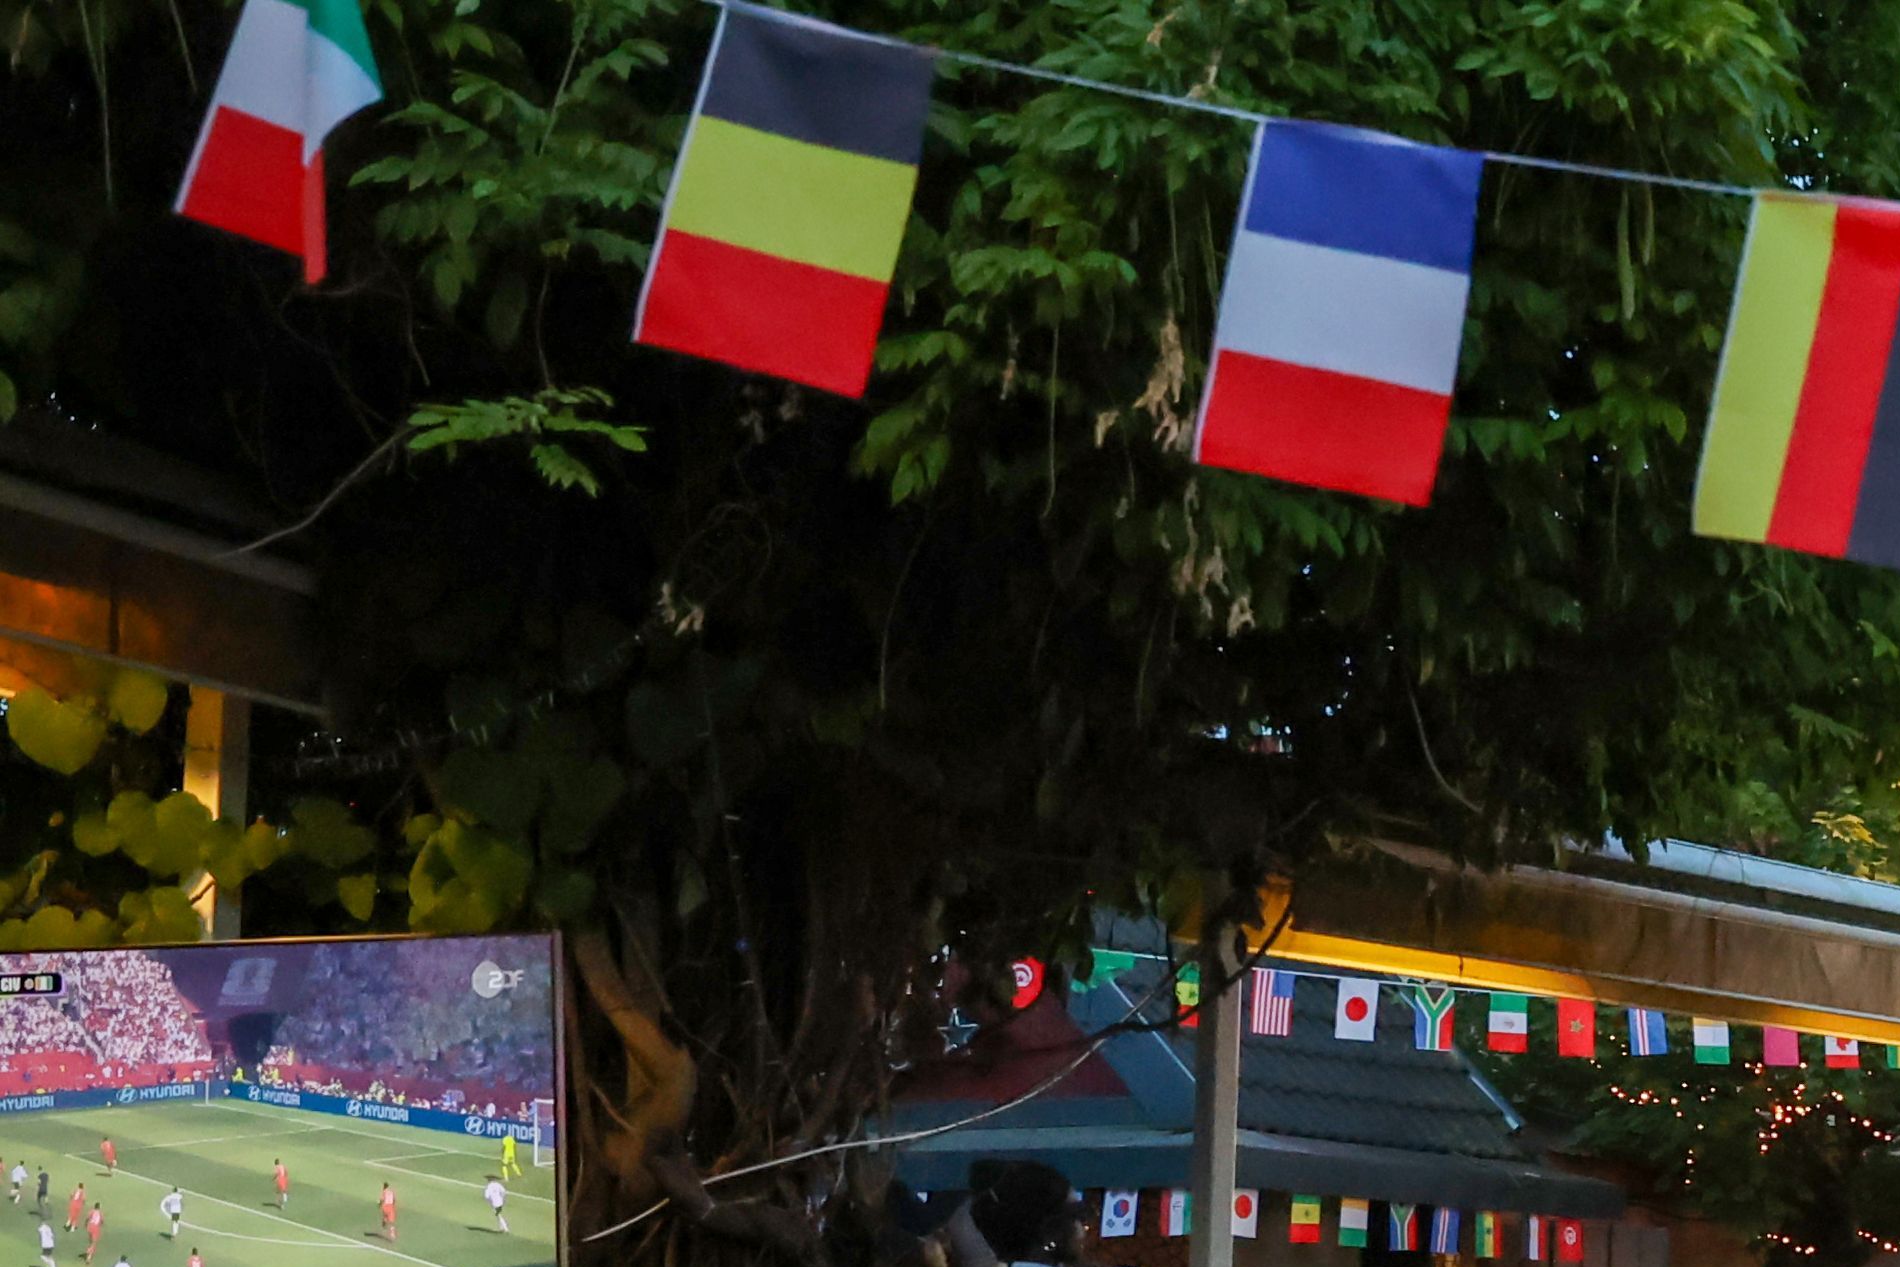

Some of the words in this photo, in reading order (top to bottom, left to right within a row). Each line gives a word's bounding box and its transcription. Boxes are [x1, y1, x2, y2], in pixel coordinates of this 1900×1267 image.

[0, 977, 21, 992] CIV
[140, 1084, 195, 1099] HYUNDAI
[363, 1103, 409, 1122] HYUNDAI
